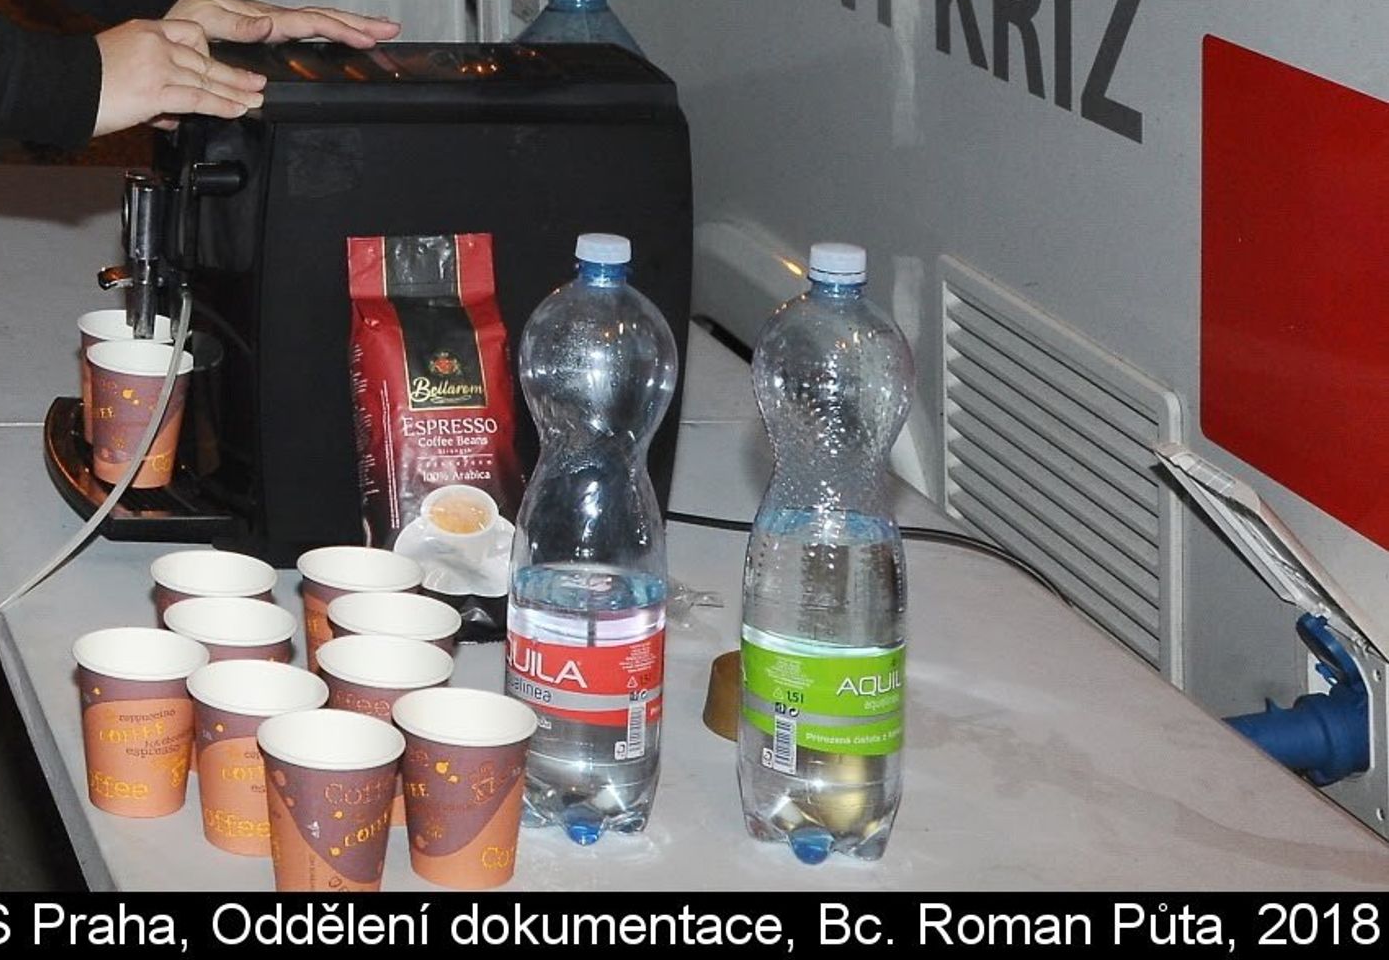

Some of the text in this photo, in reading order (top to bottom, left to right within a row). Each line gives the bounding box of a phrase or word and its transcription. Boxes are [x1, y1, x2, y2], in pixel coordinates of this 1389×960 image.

[411, 376, 483, 403] Bellarom
[402, 416, 498, 437] ESPRESSO
[418, 435, 488, 447] Coffee Beans
[452, 469, 491, 481] Arabica
[507, 640, 588, 689] UILA
[836, 670, 902, 697] AQUIL
